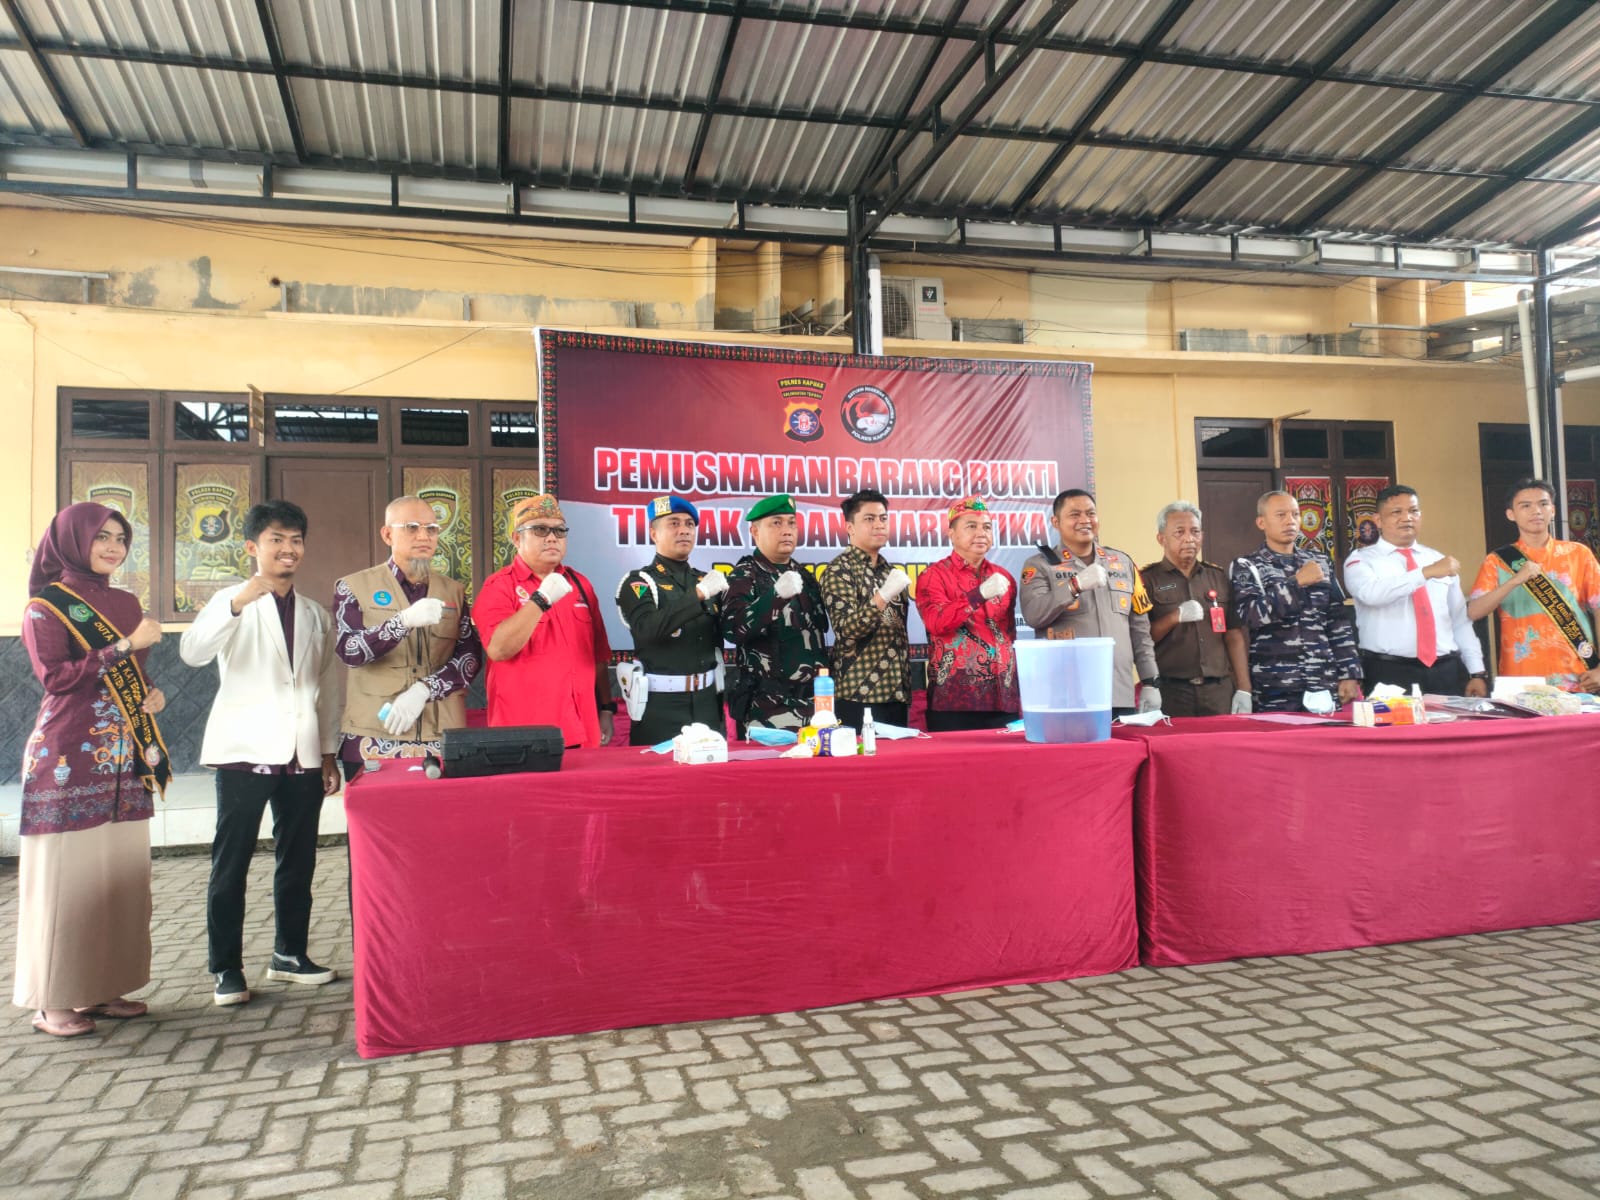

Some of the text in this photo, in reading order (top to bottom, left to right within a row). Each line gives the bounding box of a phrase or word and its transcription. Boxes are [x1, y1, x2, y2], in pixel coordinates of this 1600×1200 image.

[595, 448, 1060, 499] PEMUSNAHAN BARANG BUKTI
[610, 505, 744, 549] TIAK
[884, 510, 1051, 549] NARIKA
[93, 620, 116, 642] DUTA
